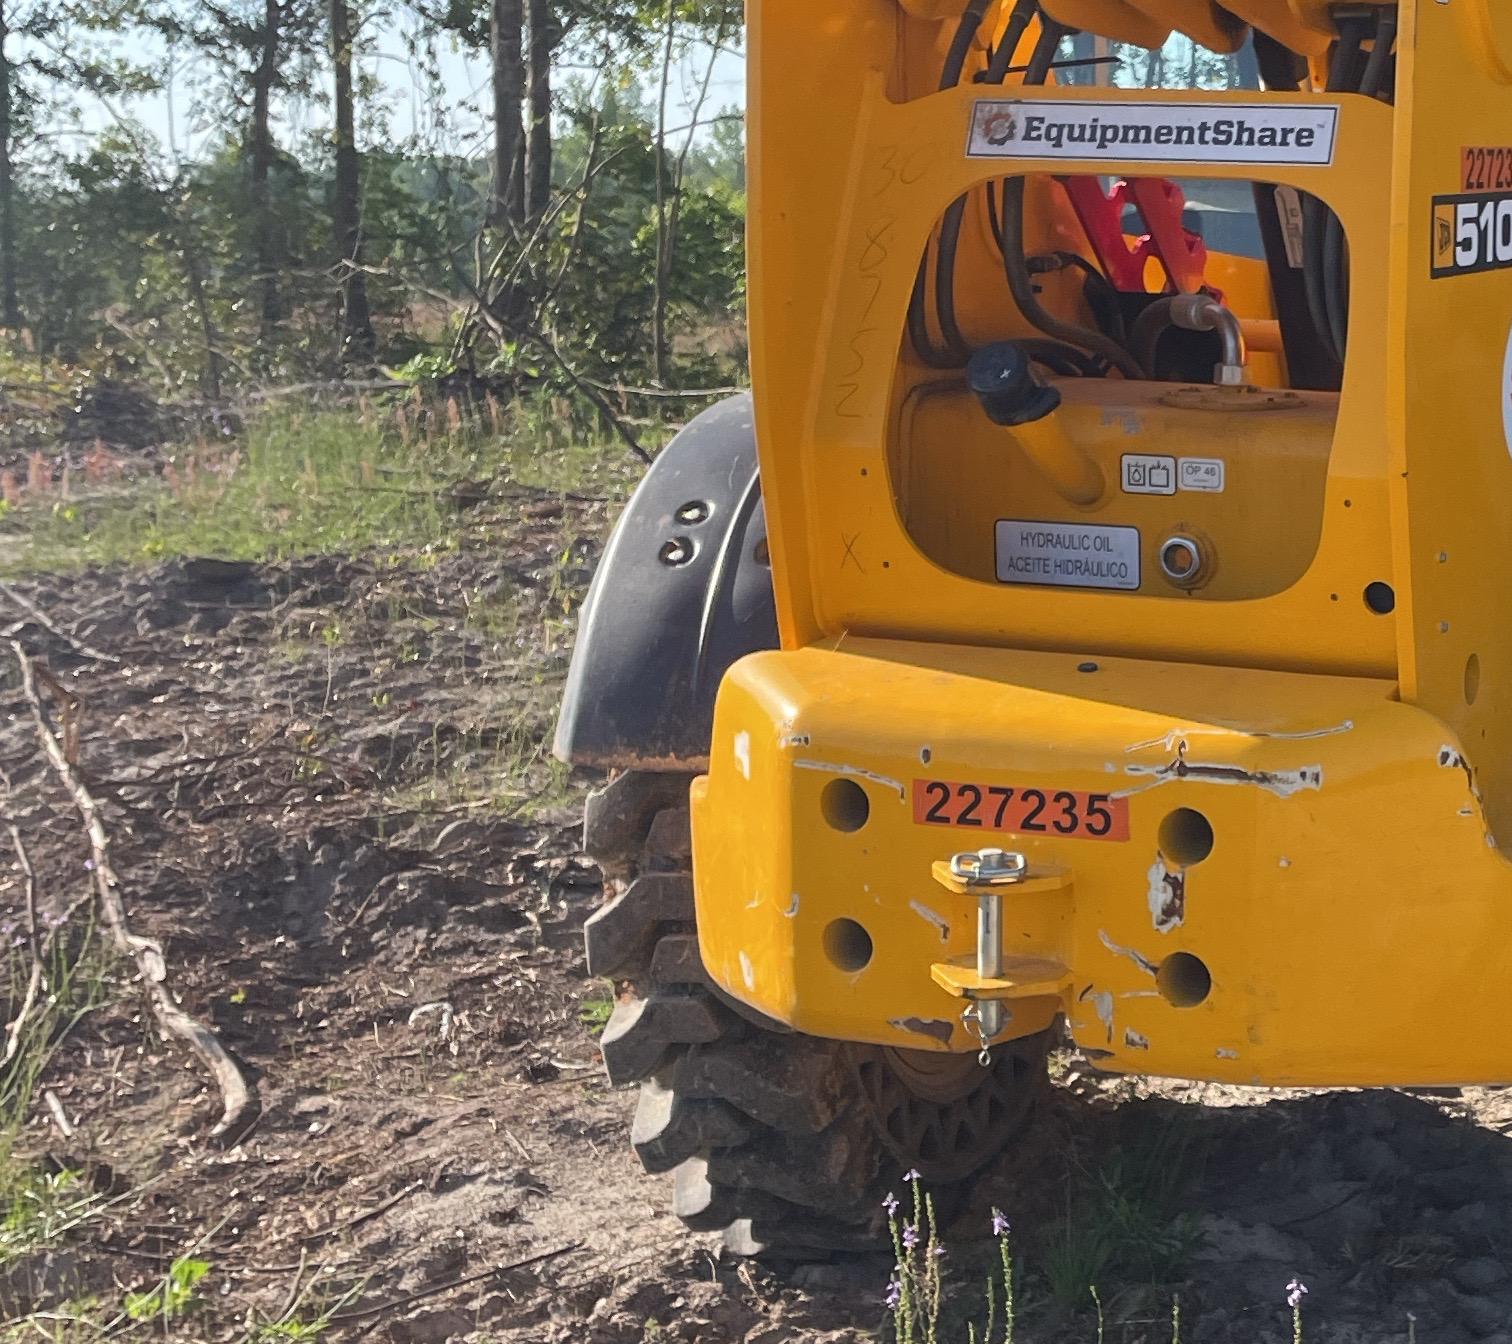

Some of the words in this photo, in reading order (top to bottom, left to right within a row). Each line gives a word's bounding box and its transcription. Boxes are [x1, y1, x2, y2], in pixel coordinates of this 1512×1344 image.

[1021, 116, 1315, 150] EquipmentShare
[1020, 530, 1090, 552] HYDRAULIC
[1093, 535, 1114, 553] OIL
[1008, 557, 1051, 574] ACEITE
[924, 781, 1112, 836] 227235
